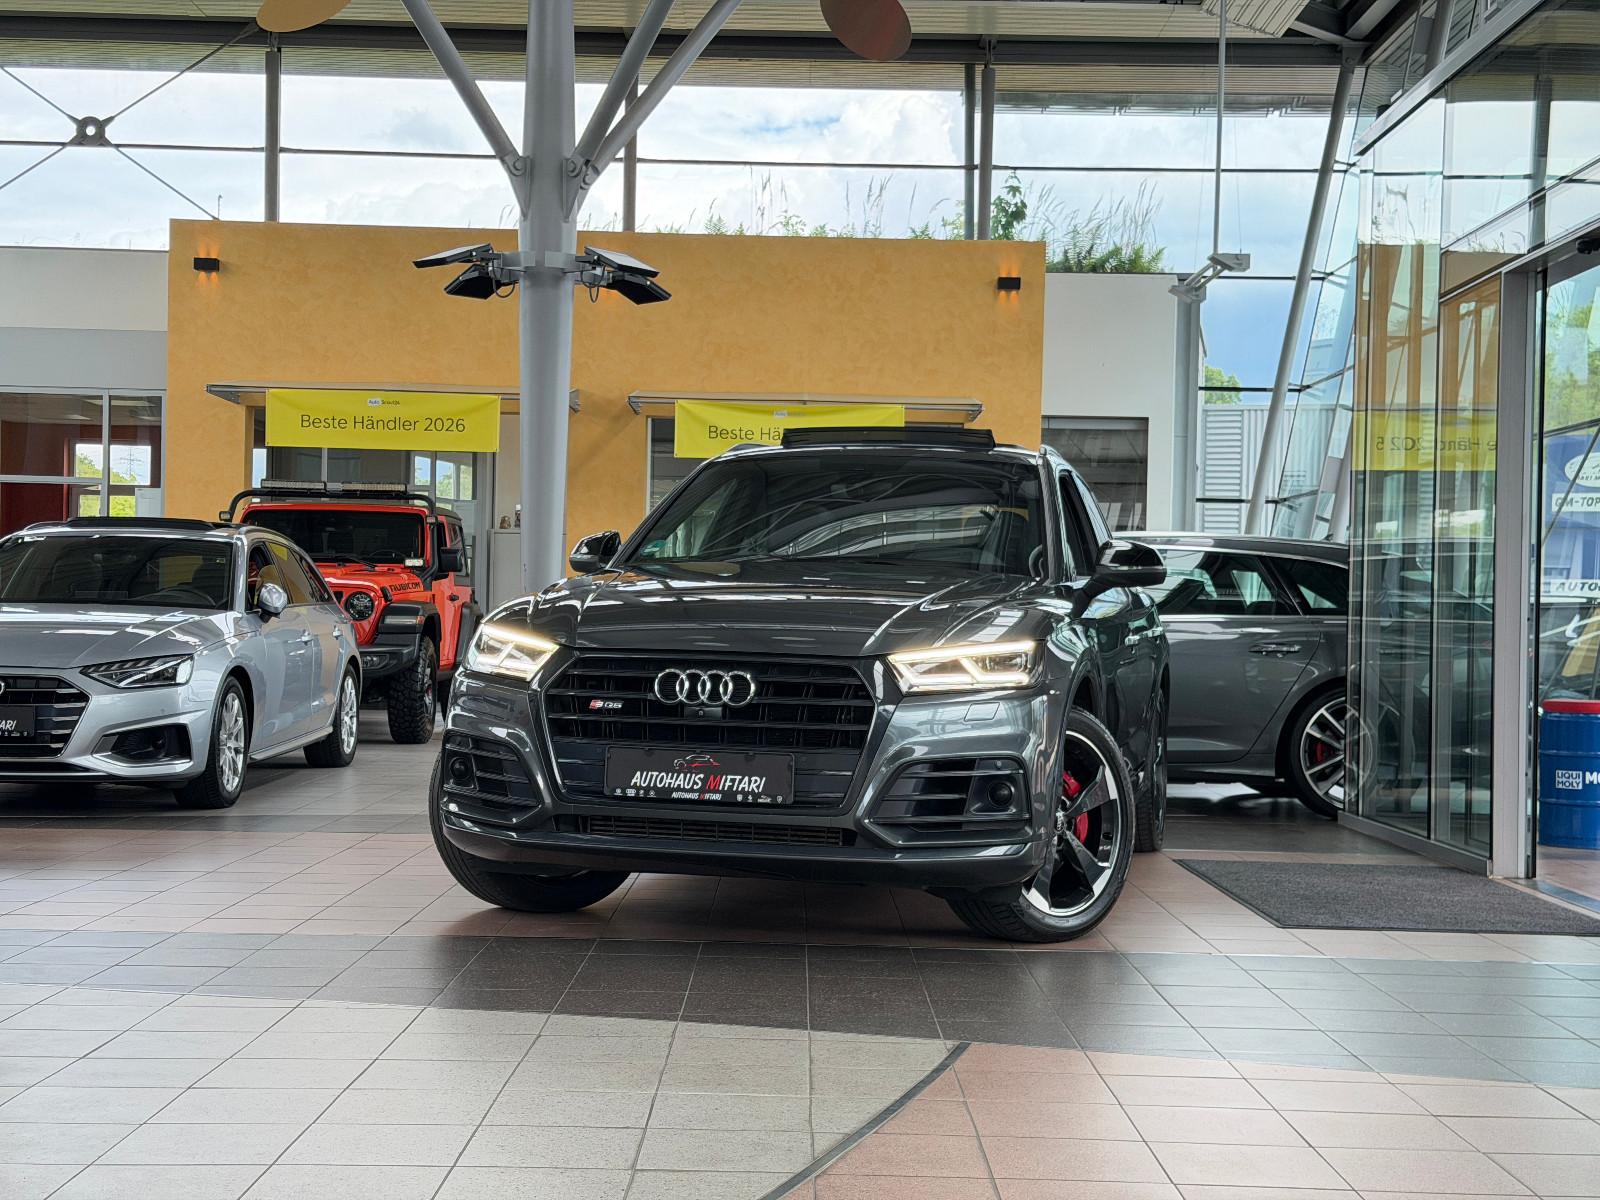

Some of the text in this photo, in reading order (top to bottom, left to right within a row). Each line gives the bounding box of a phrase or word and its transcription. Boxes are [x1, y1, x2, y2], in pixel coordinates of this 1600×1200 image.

[300, 414, 466, 433] Beste Händler 2026
[708, 425, 782, 441] Beste Hä
[1556, 582, 1600, 592] AUTO
[0, 719, 17, 731] ARI
[1557, 771, 1581, 780] LIQUI
[1585, 771, 1600, 784] M
[630, 771, 766, 793] AUTOHAUS MIFTARI
[1557, 780, 1581, 789] MOLY
[671, 791, 699, 800] AUTOHAUS
